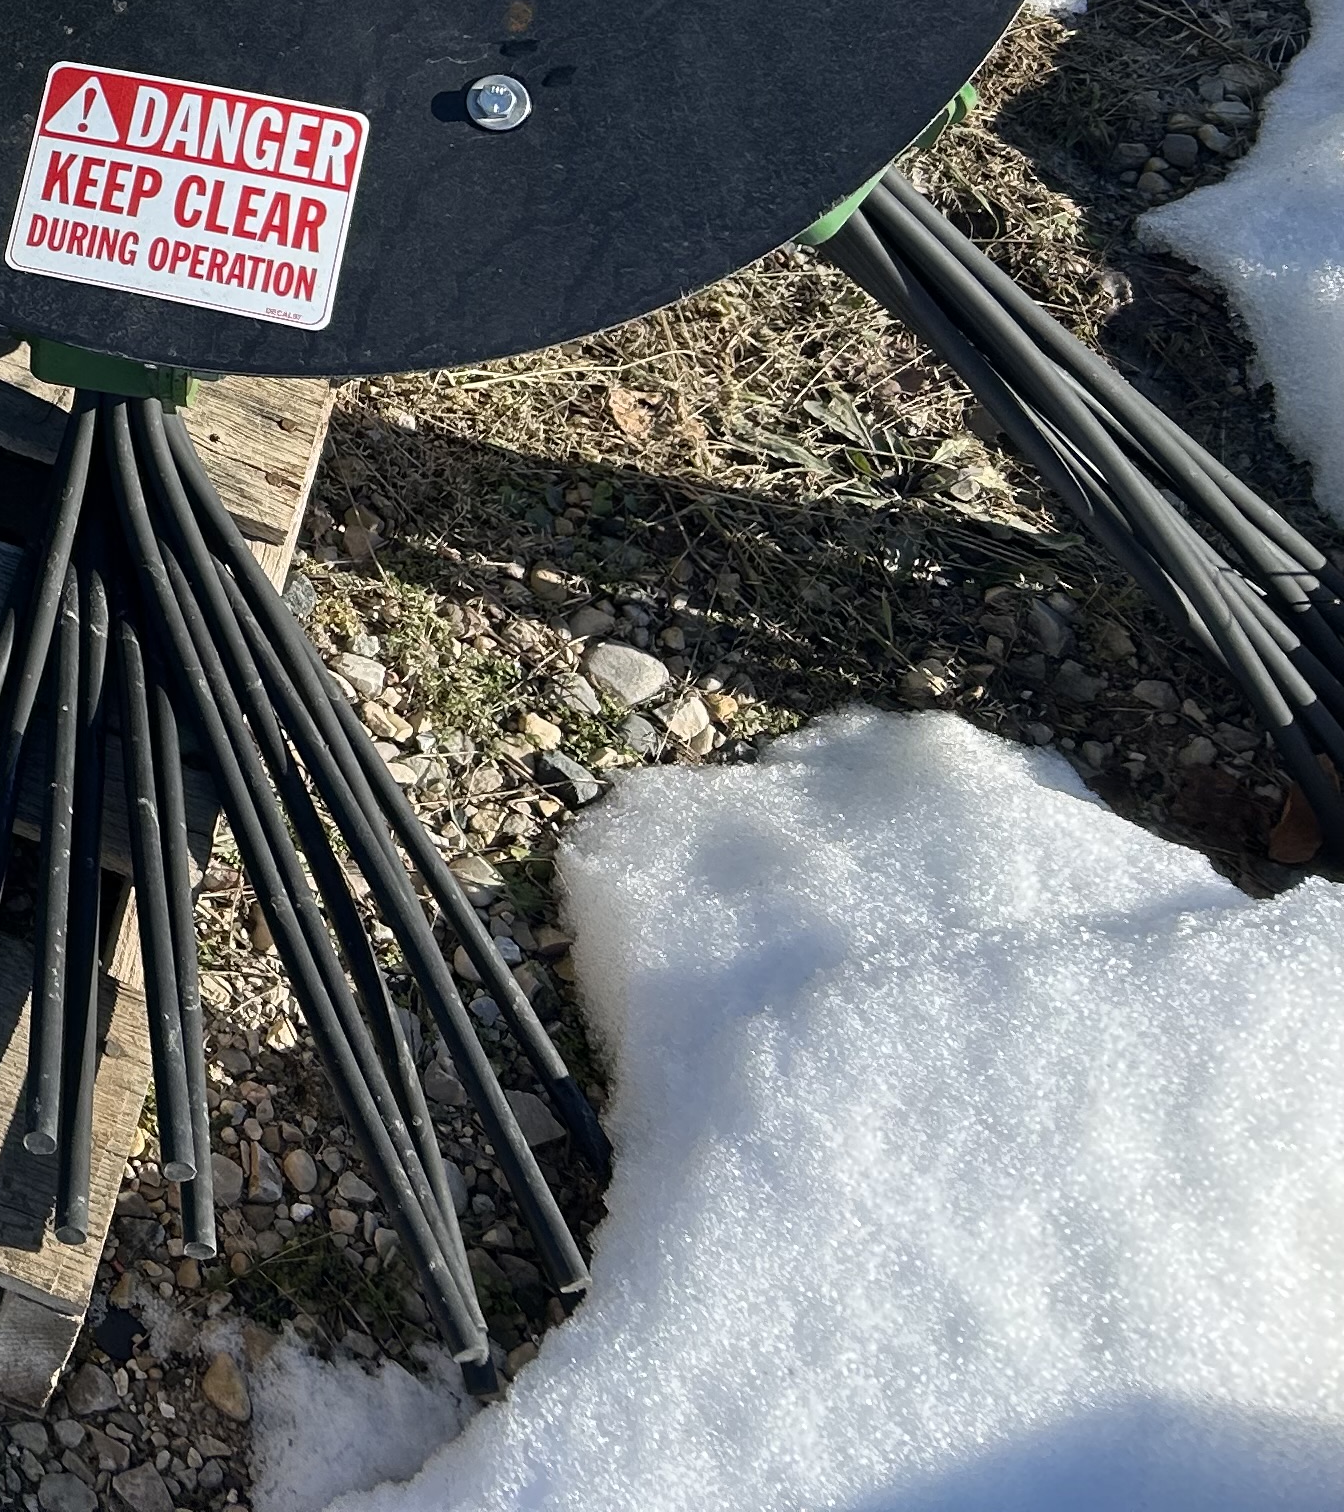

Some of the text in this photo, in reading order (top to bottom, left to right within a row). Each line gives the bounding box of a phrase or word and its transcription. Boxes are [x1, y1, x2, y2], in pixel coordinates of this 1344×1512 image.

[125, 85, 356, 186] DANGER
[40, 151, 328, 253] KEEP CLEAR
[26, 214, 318, 302] DURING OPERATION
